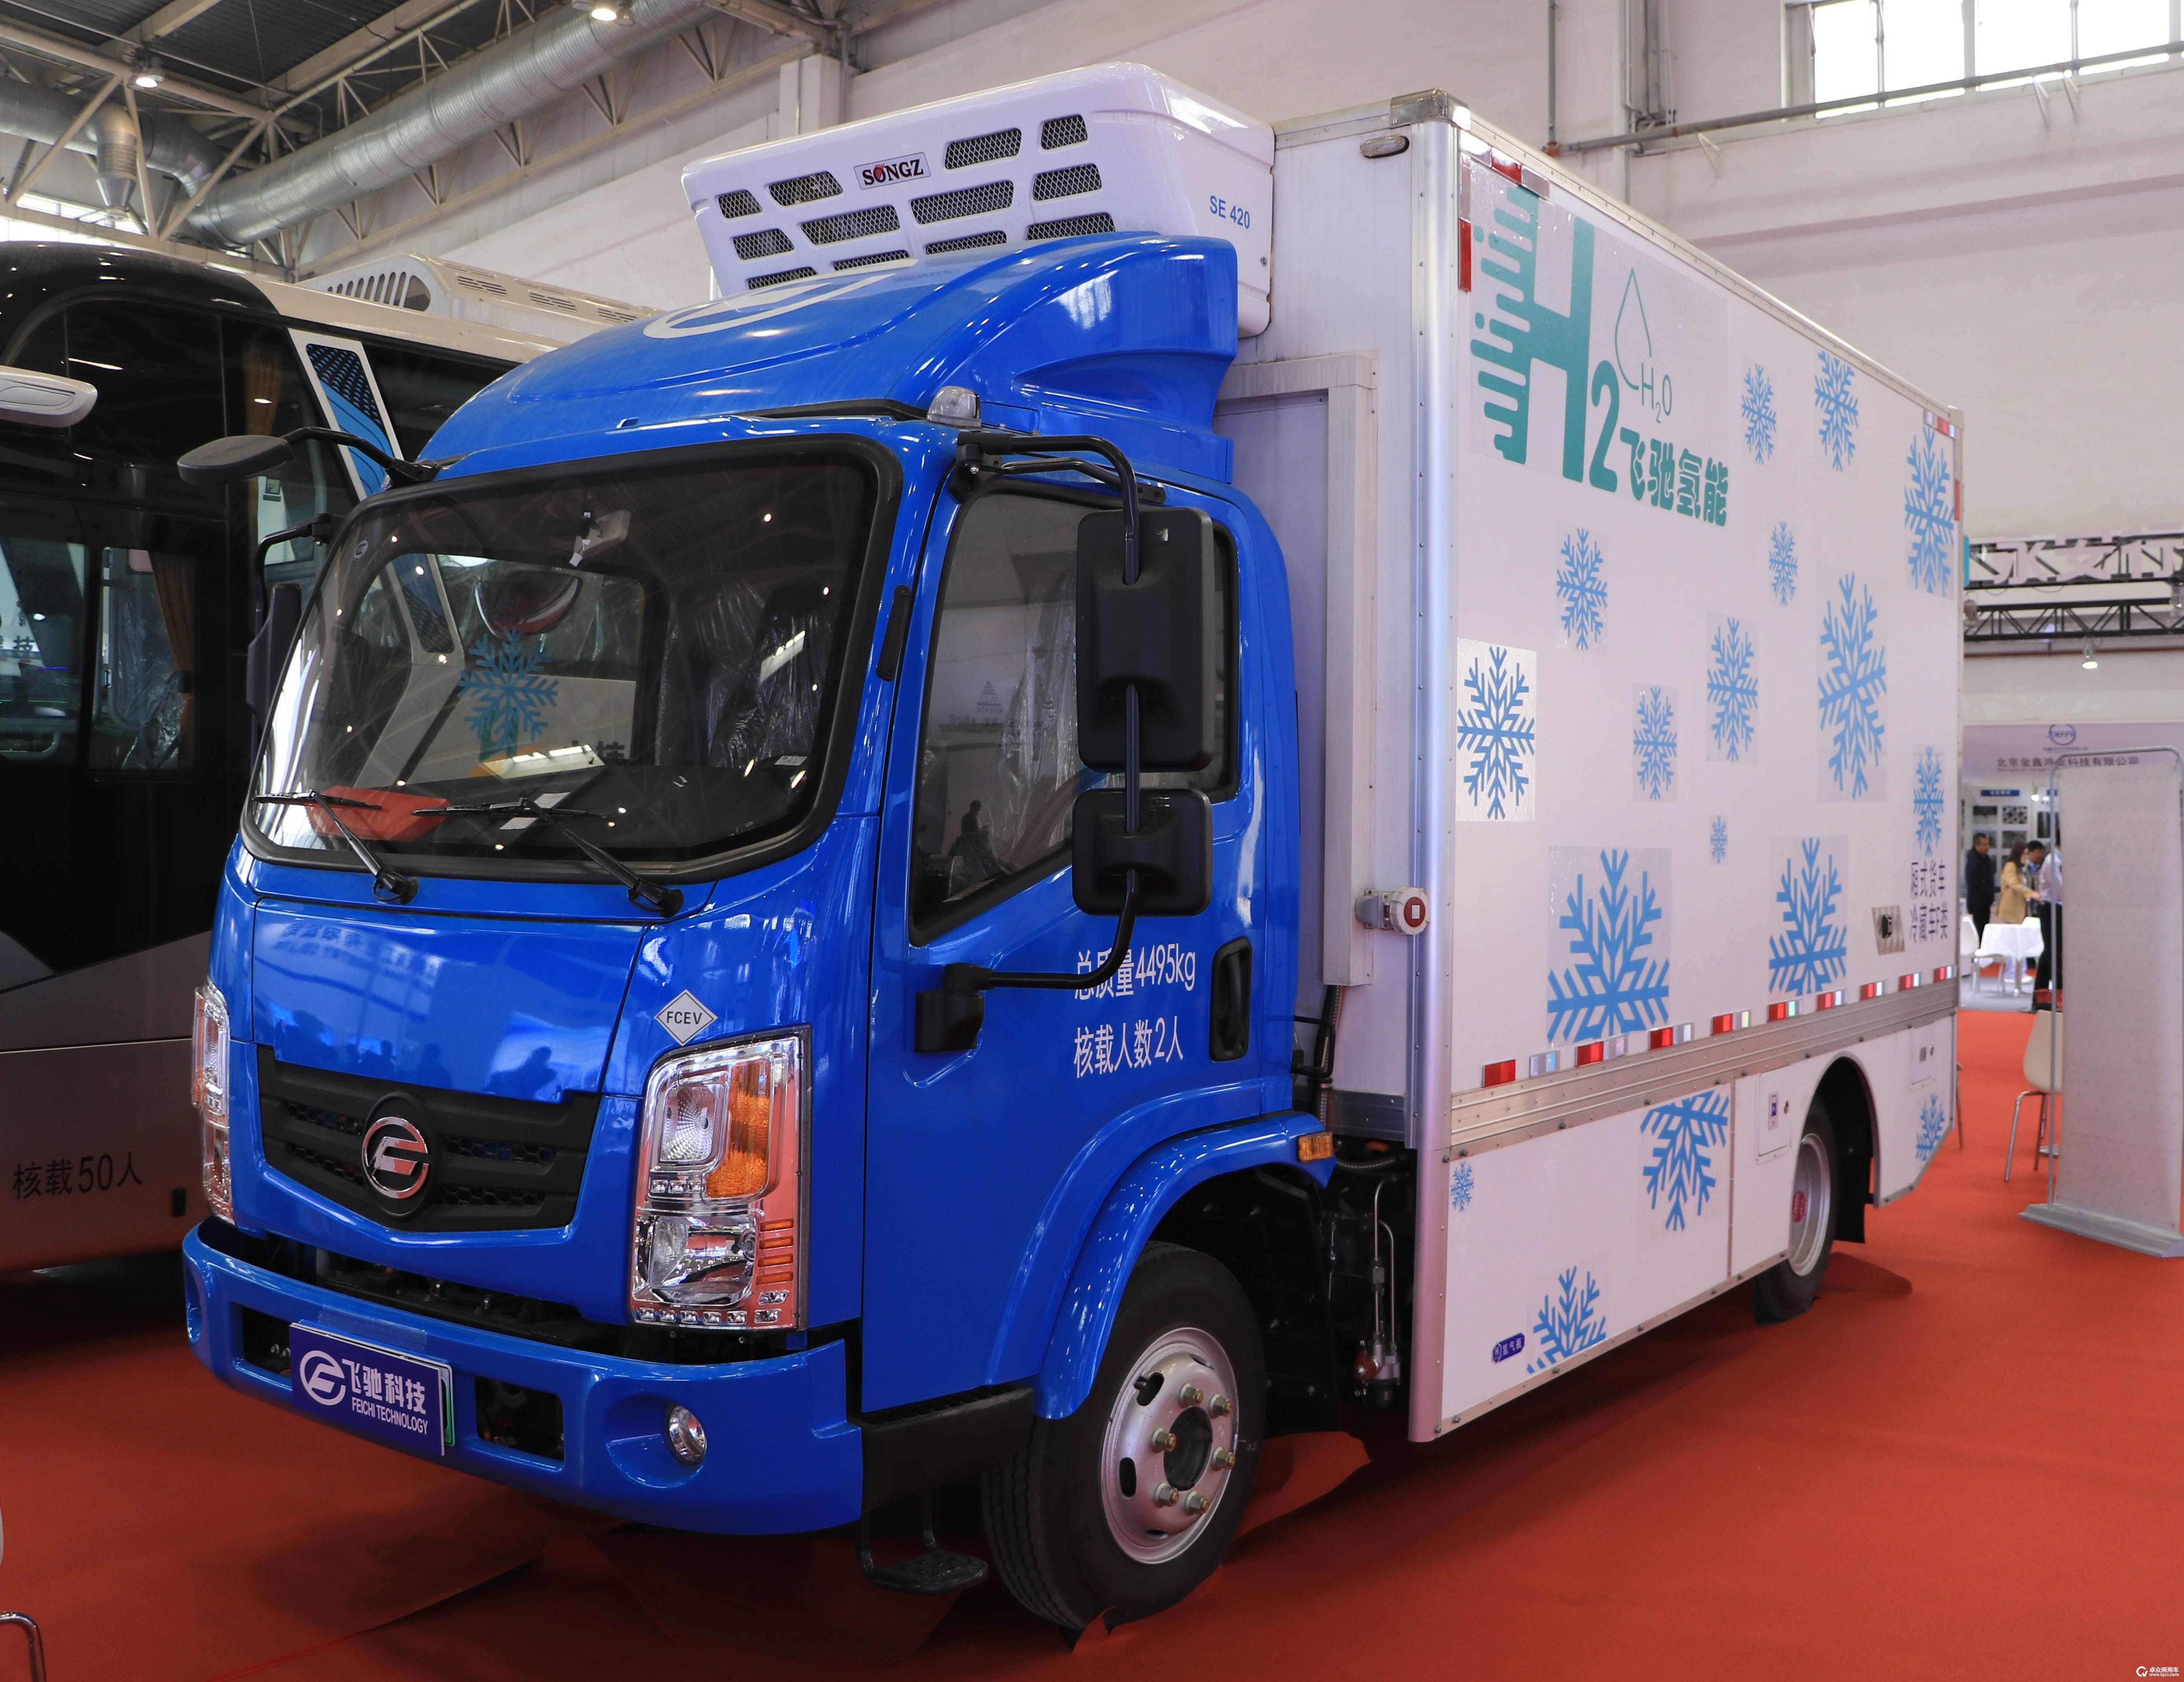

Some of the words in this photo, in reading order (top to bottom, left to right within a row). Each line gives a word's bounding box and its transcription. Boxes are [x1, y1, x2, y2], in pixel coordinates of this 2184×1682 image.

[862, 159, 924, 185] SONGZ
[1210, 195, 1226, 219] SE
[1230, 205, 1250, 229] 420
[1619, 426, 1729, 527] 飞驰氢能
[666, 1011, 703, 1025] FCEV
[1073, 1016, 1184, 1079] 核载人数2人
[12, 1151, 143, 1200] 核载50人
[341, 1358, 426, 1415] 飞驰科技
[352, 1397, 375, 1418] FEICHI
[376, 1404, 428, 1435] TECHNOLOGY
